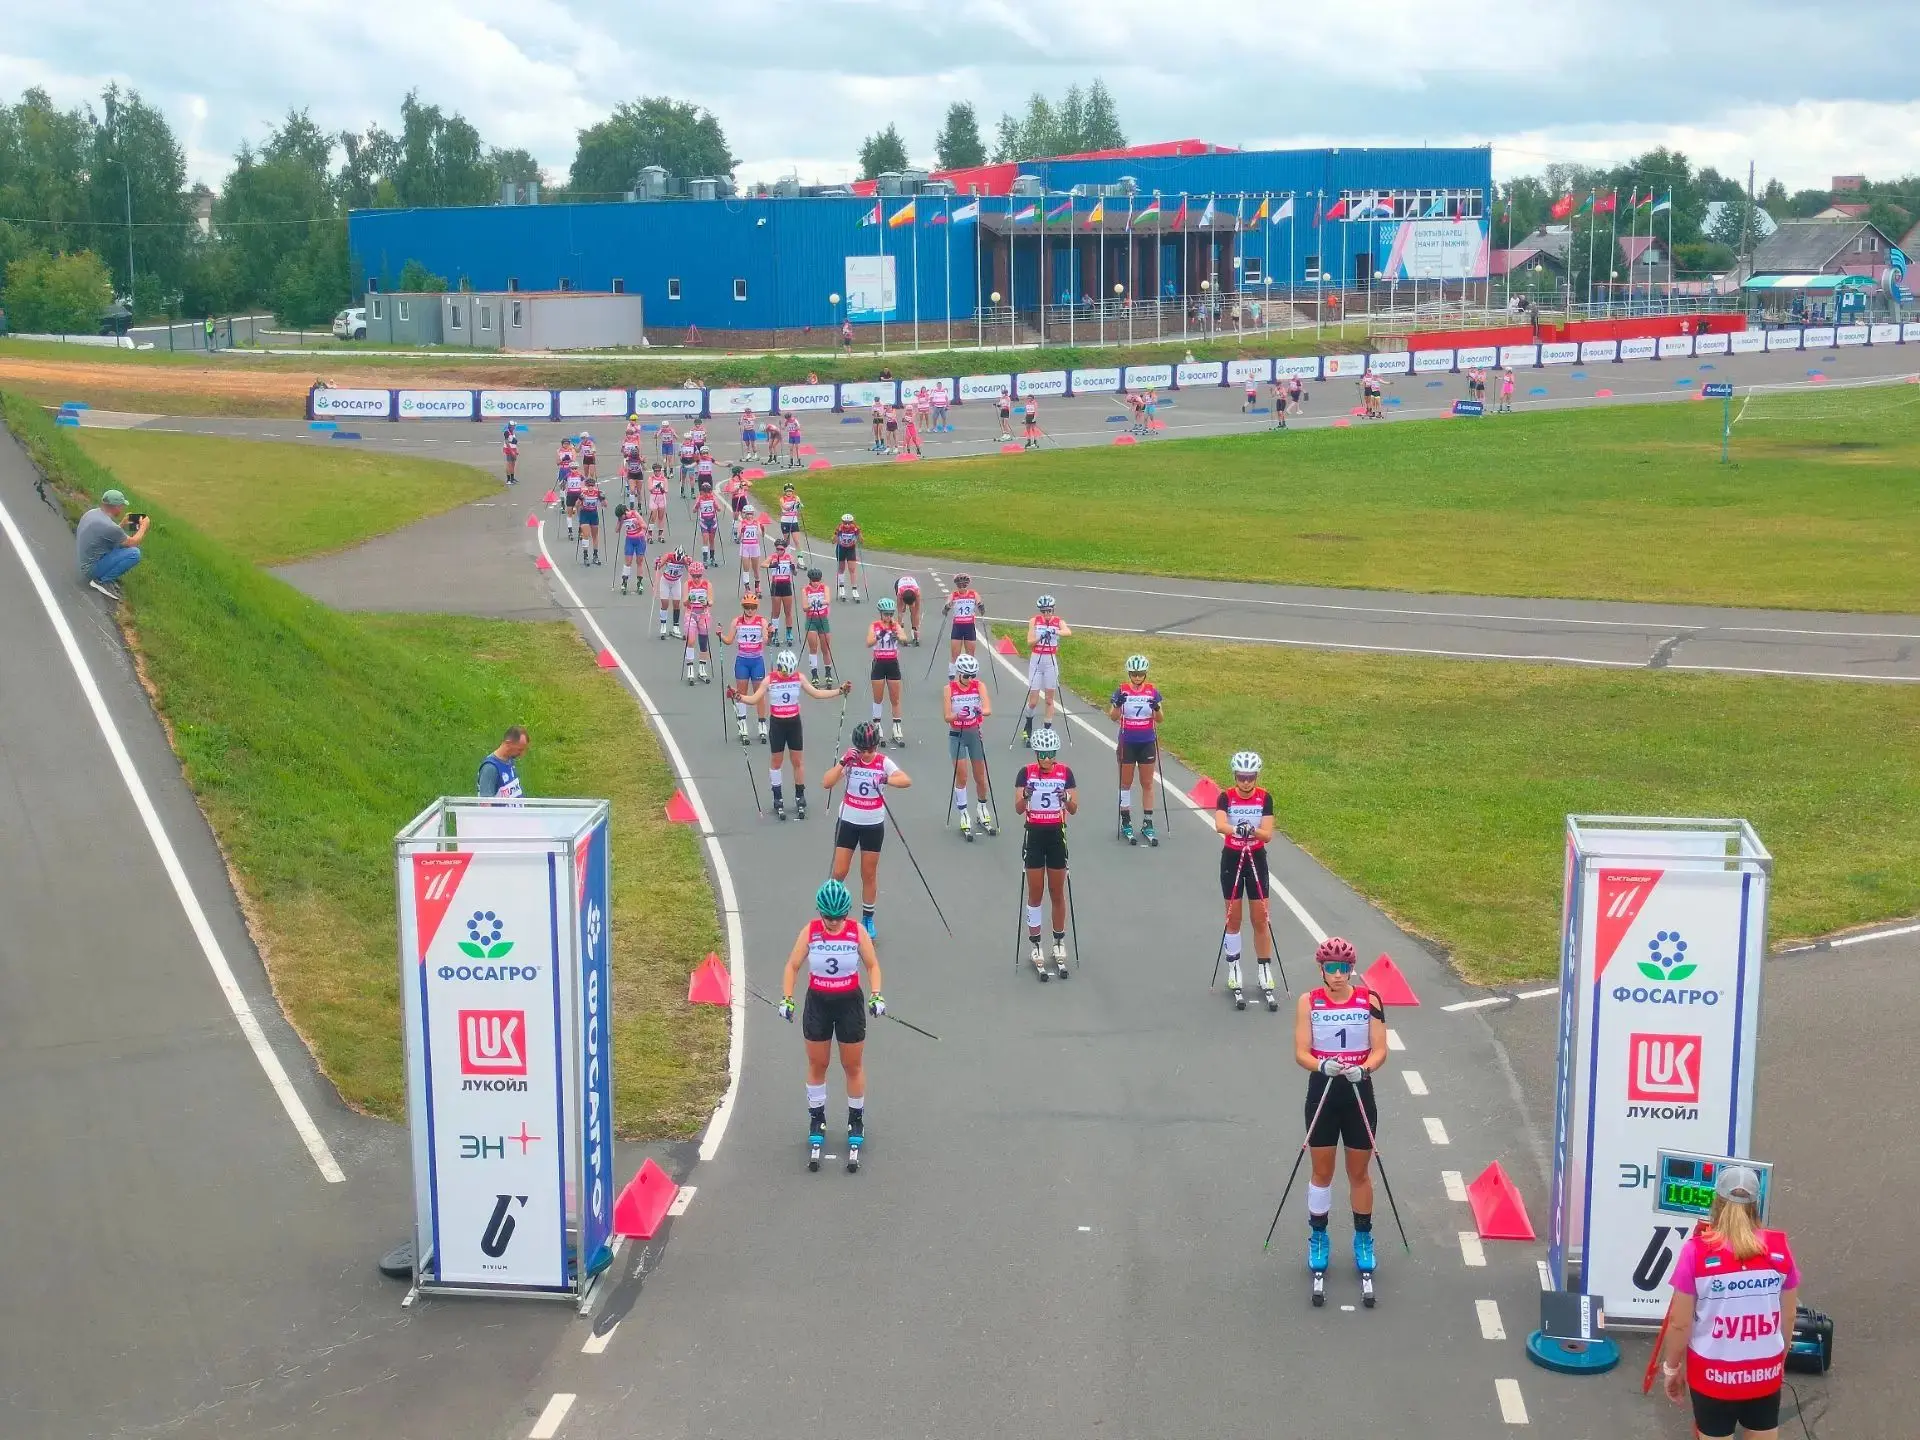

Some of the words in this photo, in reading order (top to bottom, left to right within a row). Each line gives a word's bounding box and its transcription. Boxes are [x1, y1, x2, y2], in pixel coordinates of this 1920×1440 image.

[1378, 360, 1406, 368] ФОСАГРО
[1422, 358, 1449, 366] ФОСАГРО
[1285, 365, 1315, 374] ФОСАГРО
[1136, 375, 1167, 383] ФОСАГРО
[1187, 371, 1218, 380] ФОСАГРО
[1028, 381, 1062, 390] ФОСАГРО
[1083, 378, 1115, 386] ФОСАГРО
[971, 384, 1006, 394] ФОСАГРО
[331, 400, 383, 410] ФОСАГРО
[651, 400, 696, 409] ФОСАГРО
[791, 395, 829, 405] ФОСАГРО
[416, 401, 465, 411] ФОСАГРО
[497, 401, 545, 410] ФОСАГРО
[959, 606, 970, 615] 13
[742, 633, 757, 642] 12
[782, 692, 791, 704] 9
[1133, 705, 1144, 717] 7
[859, 782, 869, 796] 6
[1040, 792, 1052, 808] 5
[817, 944, 857, 952] ФОСАГРО
[825, 958, 839, 975] 3
[438, 966, 538, 981] ФОСАГРО
[1613, 987, 1719, 1006] ФОСАГРО
[1323, 1013, 1369, 1022] ФОСАГРО
[1335, 1028, 1347, 1049] 1
[462, 1078, 528, 1092] ЛУКОЙЛ
[588, 969, 602, 1219] ФОСАГРО
[1626, 1106, 1698, 1121] ЛУКОЙЛ
[1669, 1183, 1716, 1206] 10:5
